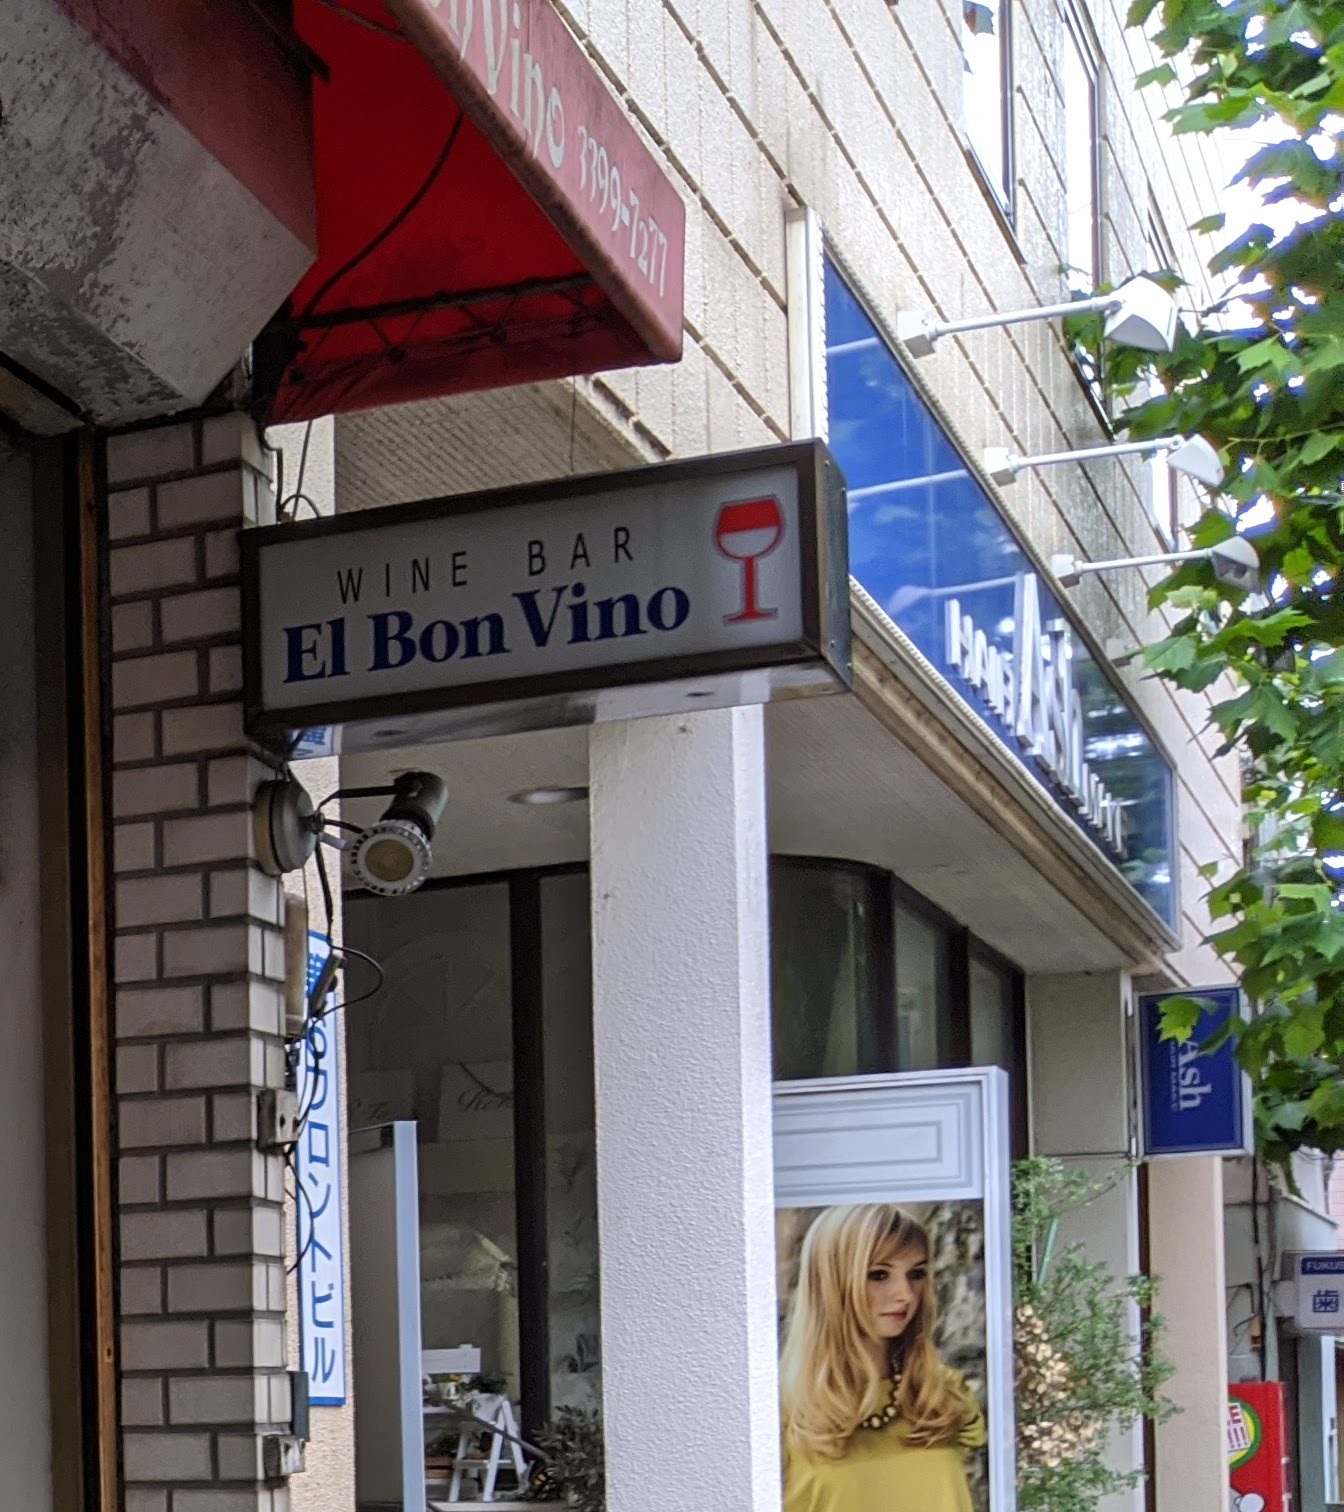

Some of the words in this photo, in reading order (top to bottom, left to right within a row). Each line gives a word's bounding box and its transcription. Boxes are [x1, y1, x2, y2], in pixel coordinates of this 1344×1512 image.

[337, 550, 470, 605] WINE
[527, 526, 636, 577] BAR
[281, 616, 351, 685] El
[367, 608, 511, 673] Bon
[512, 581, 691, 652] Vino
[1179, 1040, 1213, 1111] Ash
